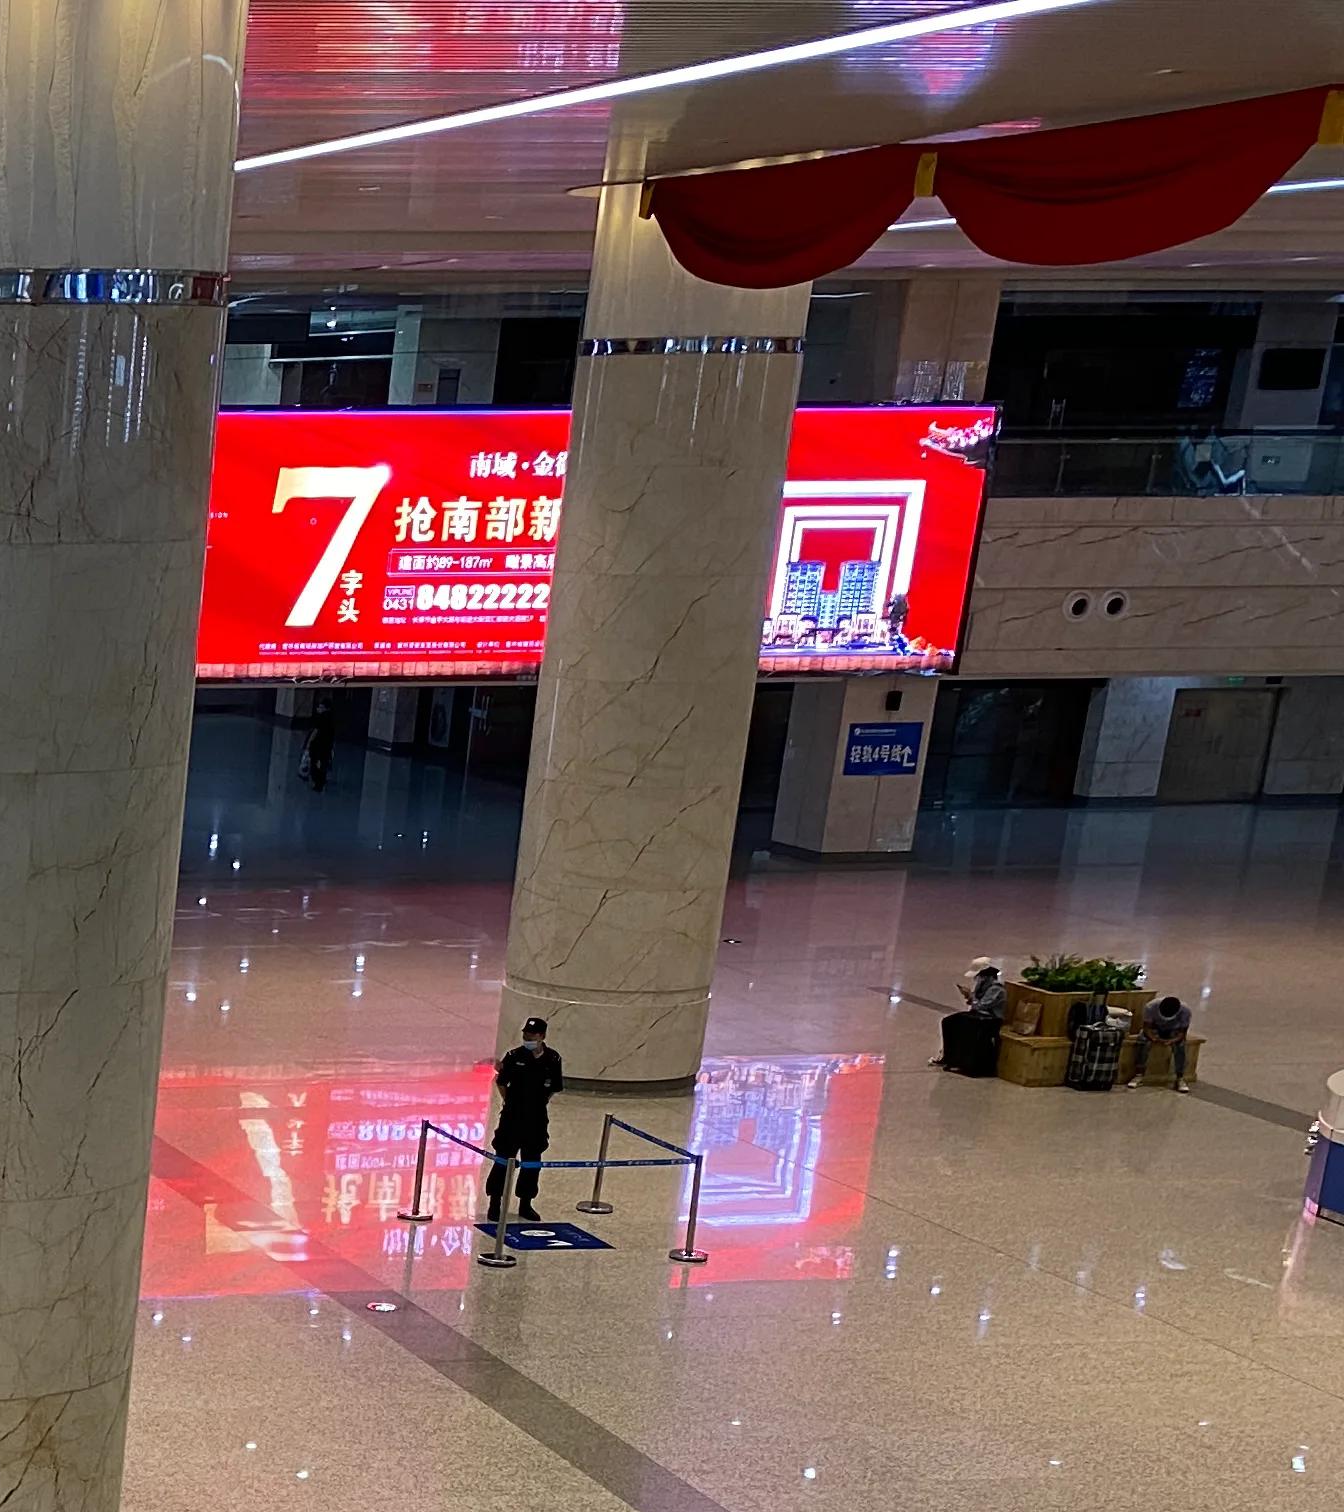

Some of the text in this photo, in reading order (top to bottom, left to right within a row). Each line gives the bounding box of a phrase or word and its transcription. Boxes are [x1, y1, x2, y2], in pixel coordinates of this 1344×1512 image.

[394, 496, 562, 543] 抢南部新
[271, 464, 391, 626] 7
[336, 569, 363, 623] 字头
[416, 584, 551, 610] 84822222
[850, 744, 901, 763] 轻轨4号线
